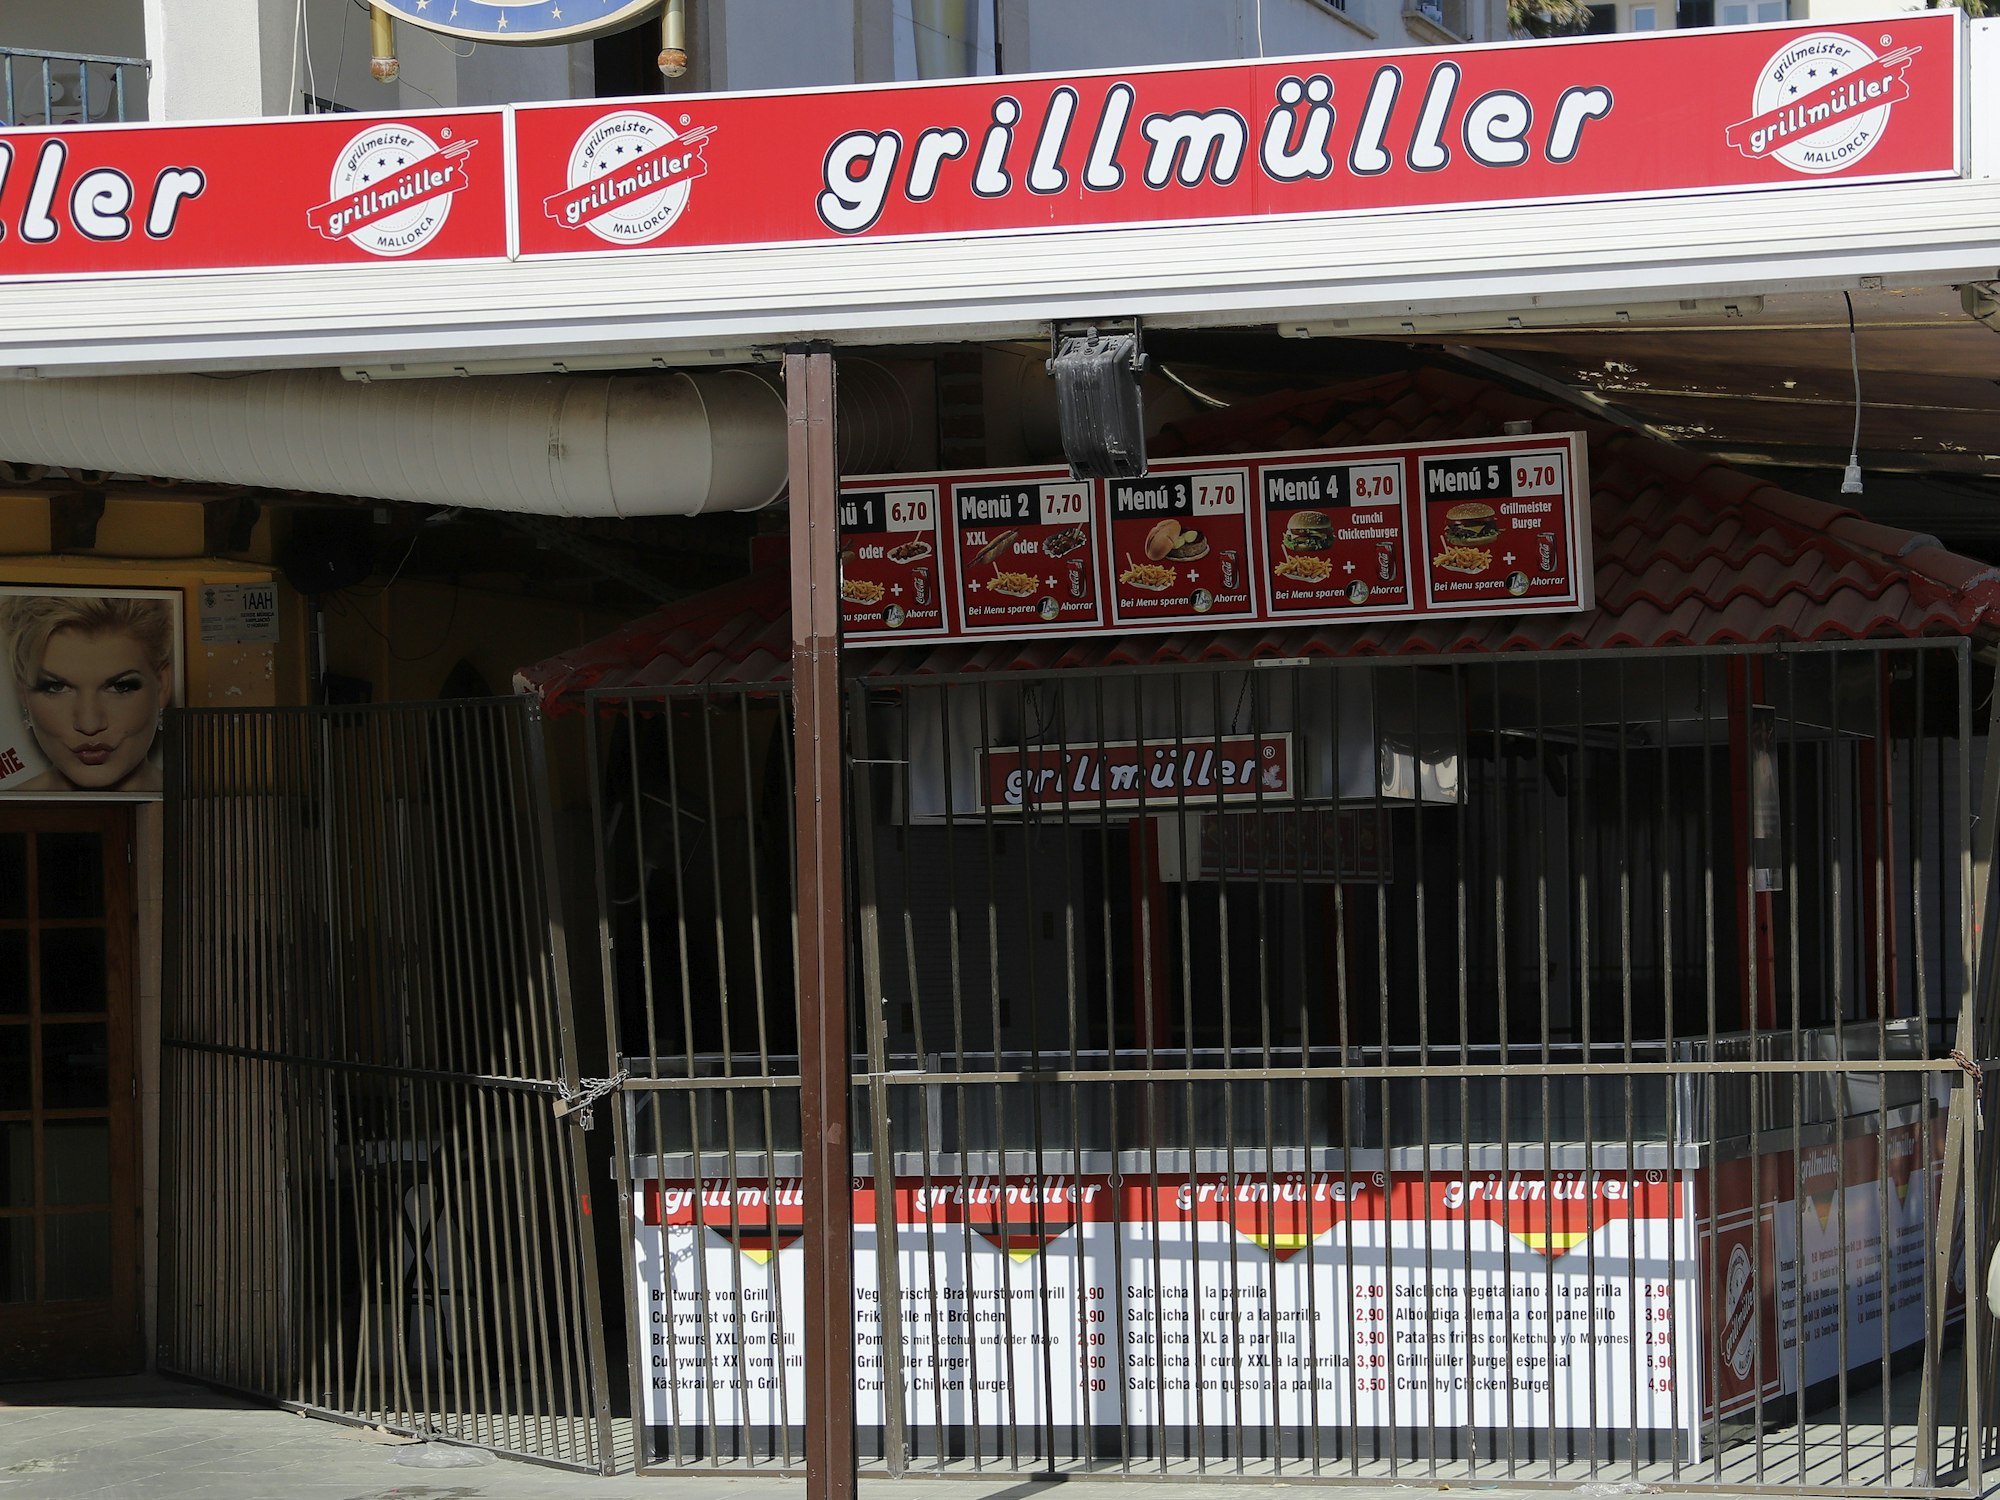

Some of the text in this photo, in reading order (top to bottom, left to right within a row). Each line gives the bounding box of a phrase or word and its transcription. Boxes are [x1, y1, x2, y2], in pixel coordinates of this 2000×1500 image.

[1773, 42, 1850, 82] grillmeister
[1750, 75, 1893, 153] grillmüller
[585, 121, 653, 158] grillmeister
[816, 60, 1613, 234] grillmüller
[1803, 131, 1869, 162] MALLORCA
[348, 133, 414, 171] grillmeister
[566, 152, 693, 224] grillmüller
[329, 166, 453, 234] grillmüller
[613, 206, 672, 234] MALLORCA
[377, 216, 434, 247] MALLORCA
[1428, 465, 1555, 493] Menú 5 9,70
[1269, 475, 1393, 502] Menú 4 8,70
[1117, 484, 1235, 511] Menú 3 7,70
[864, 501, 873, 525] 1
[892, 502, 927, 523] 6,70
[961, 493, 1082, 520] Menü 2 7,70
[1500, 501, 1552, 515] Grillmeister
[1351, 512, 1384, 525] Crunchi
[1511, 517, 1542, 529] Burger
[1338, 527, 1399, 540] Chickenburger
[966, 531, 1038, 554] XXL oder
[859, 544, 884, 559] oder
[1434, 582, 1448, 592] Bei
[1450, 581, 1473, 590] Menu
[1475, 580, 1505, 590] sparen
[1530, 576, 1565, 586] Ahorrar
[1276, 590, 1289, 600] Bei
[1291, 590, 1314, 599] Menu
[1315, 589, 1345, 599] sparen
[1370, 585, 1404, 595] Ahorrar
[243, 592, 273, 610] 1AAH
[969, 606, 981, 615] Bei
[983, 605, 1005, 615] Menu
[1007, 605, 1036, 615] sparen
[1061, 602, 1093, 611] Ahorrar
[1121, 599, 1134, 608] Bei
[1136, 598, 1158, 607] Menu
[1160, 597, 1189, 607] sparen
[1214, 594, 1247, 603] Ahorrar
[854, 612, 881, 622] sparen
[906, 609, 938, 618] Ahorrar
[1801, 1146, 1838, 1184] grillmülle
[664, 1177, 803, 1215] grillmüll
[652, 1289, 711, 1301] Brtwurt
[744, 1288, 768, 1301] Grill
[1010, 1290, 1034, 1299] vom
[1039, 1287, 1064, 1299] rill
[1128, 1286, 1188, 1298] Salcicha
[1206, 1286, 1216, 1298] la
[1356, 1285, 1384, 1299] 2,90
[1463, 1286, 1540, 1299] egetaiano
[1558, 1284, 1569, 1297] la
[1574, 1284, 1621, 1299] parilla
[652, 1311, 718, 1325] Curywust
[751, 1311, 775, 1323] Grill
[949, 1309, 1005, 1322] Bröchen
[1128, 1309, 1189, 1321] Salcicha
[1247, 1312, 1254, 1321] a
[1259, 1308, 1270, 1321] la
[1277, 1309, 1320, 1323] parrila
[1356, 1308, 1384, 1322] 2,90
[1464, 1308, 1519, 1320] lemaa
[1556, 1308, 1615, 1322] paneillo
[652, 1333, 710, 1345] Brawurs
[716, 1333, 737, 1345] XXL
[770, 1333, 795, 1345] Gill
[914, 1335, 929, 1345] mit
[936, 1334, 975, 1345] etchu
[1128, 1332, 1385, 1346] Salcicha XL a parilla 3,90
[1560, 1333, 1576, 1345] y/o
[1580, 1333, 1629, 1346] Myones
[652, 1355, 802, 1369] Cuywurt XX vom rill
[858, 1356, 922, 1367] Grillller
[1129, 1355, 1189, 1367] Salcicha
[1248, 1355, 1271, 1367] XXL
[1288, 1355, 1298, 1367] la
[1303, 1355, 1349, 1369] prrilla
[1357, 1355, 1385, 1369] 3,90
[1471, 1356, 1507, 1369] Burge
[1516, 1354, 1571, 1369] espeial
[653, 1377, 724, 1389] Käsekraier
[758, 1377, 779, 1389] Gril
[914, 1378, 963, 1391] Chiken
[968, 1379, 1010, 1392] urger
[1129, 1378, 1190, 1390] Salcicha
[1264, 1381, 1271, 1390] a
[1358, 1378, 1385, 1393] 3,50
[1397, 1377, 1450, 1392] Crunhy
[1511, 1378, 1549, 1392] Burge
